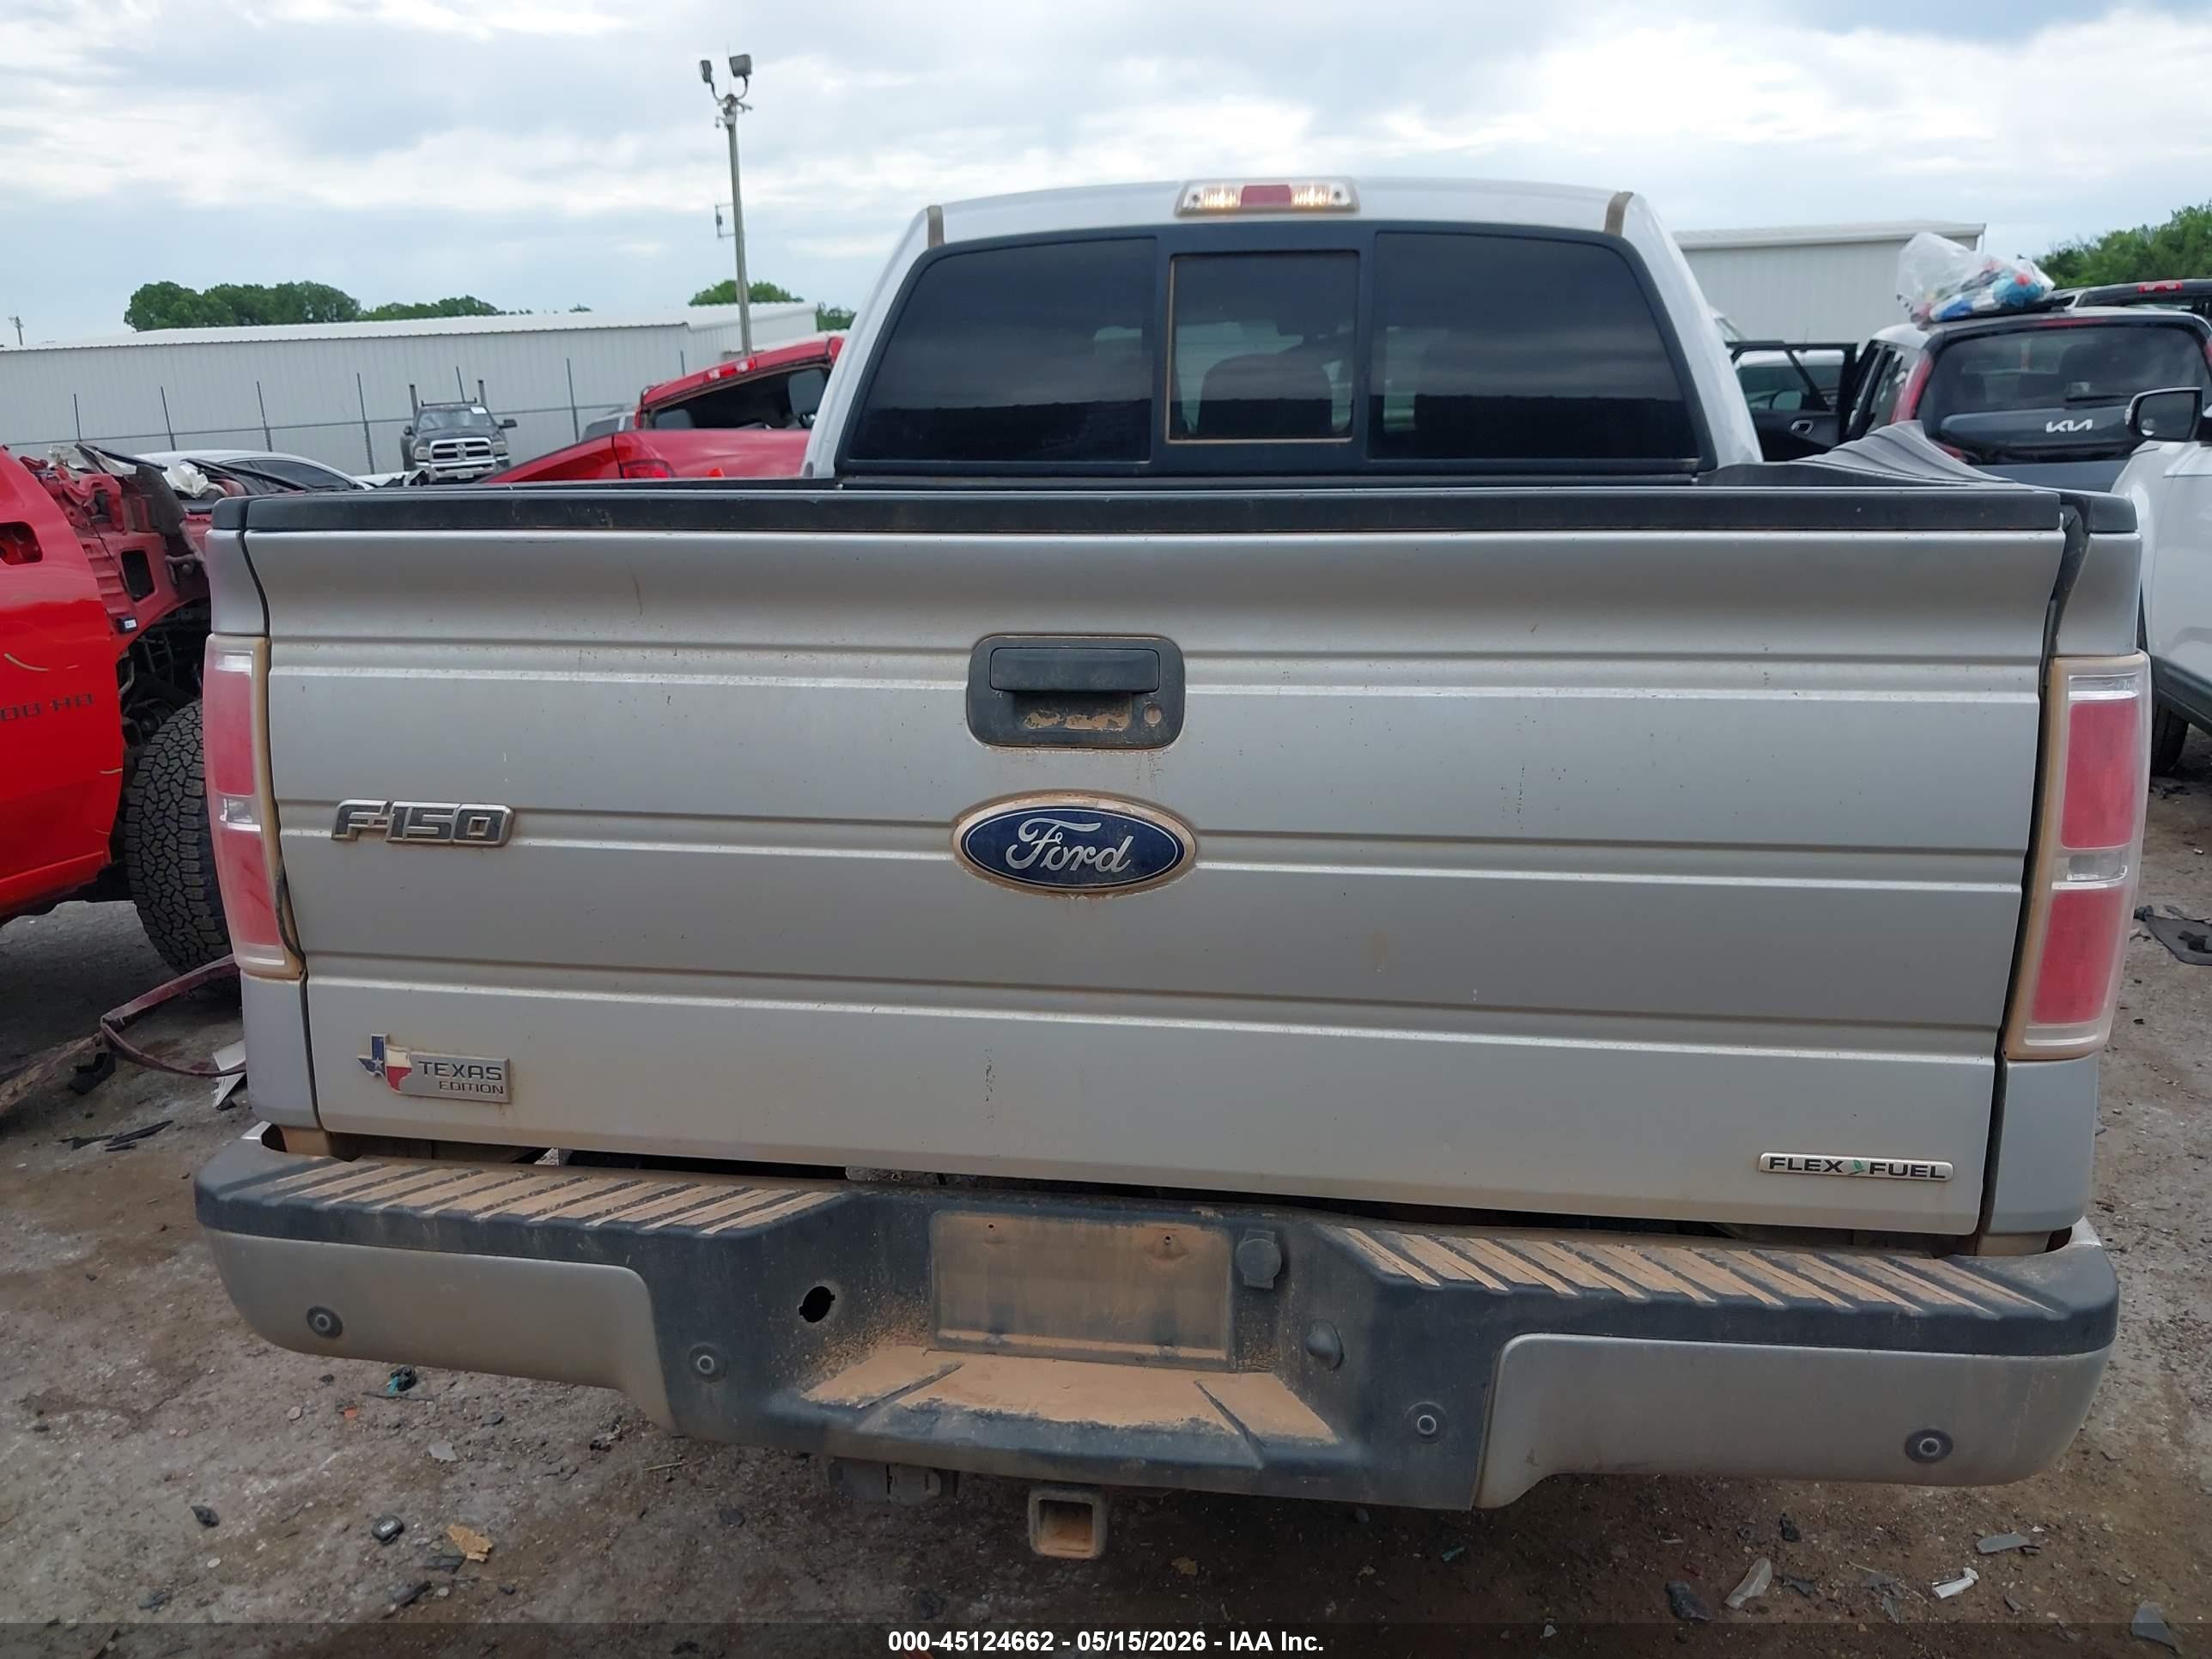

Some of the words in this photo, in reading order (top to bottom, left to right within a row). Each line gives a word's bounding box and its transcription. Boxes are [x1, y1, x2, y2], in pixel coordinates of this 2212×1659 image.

[2045, 418, 2094, 434] KIA
[331, 799, 515, 848] F-150
[1006, 817, 1134, 873] Ford
[418, 1060, 502, 1081] TEXAS
[439, 1080, 504, 1095] EDITION
[1769, 1157, 1844, 1173] FLEX
[1869, 1162, 1947, 1179] FUEL
